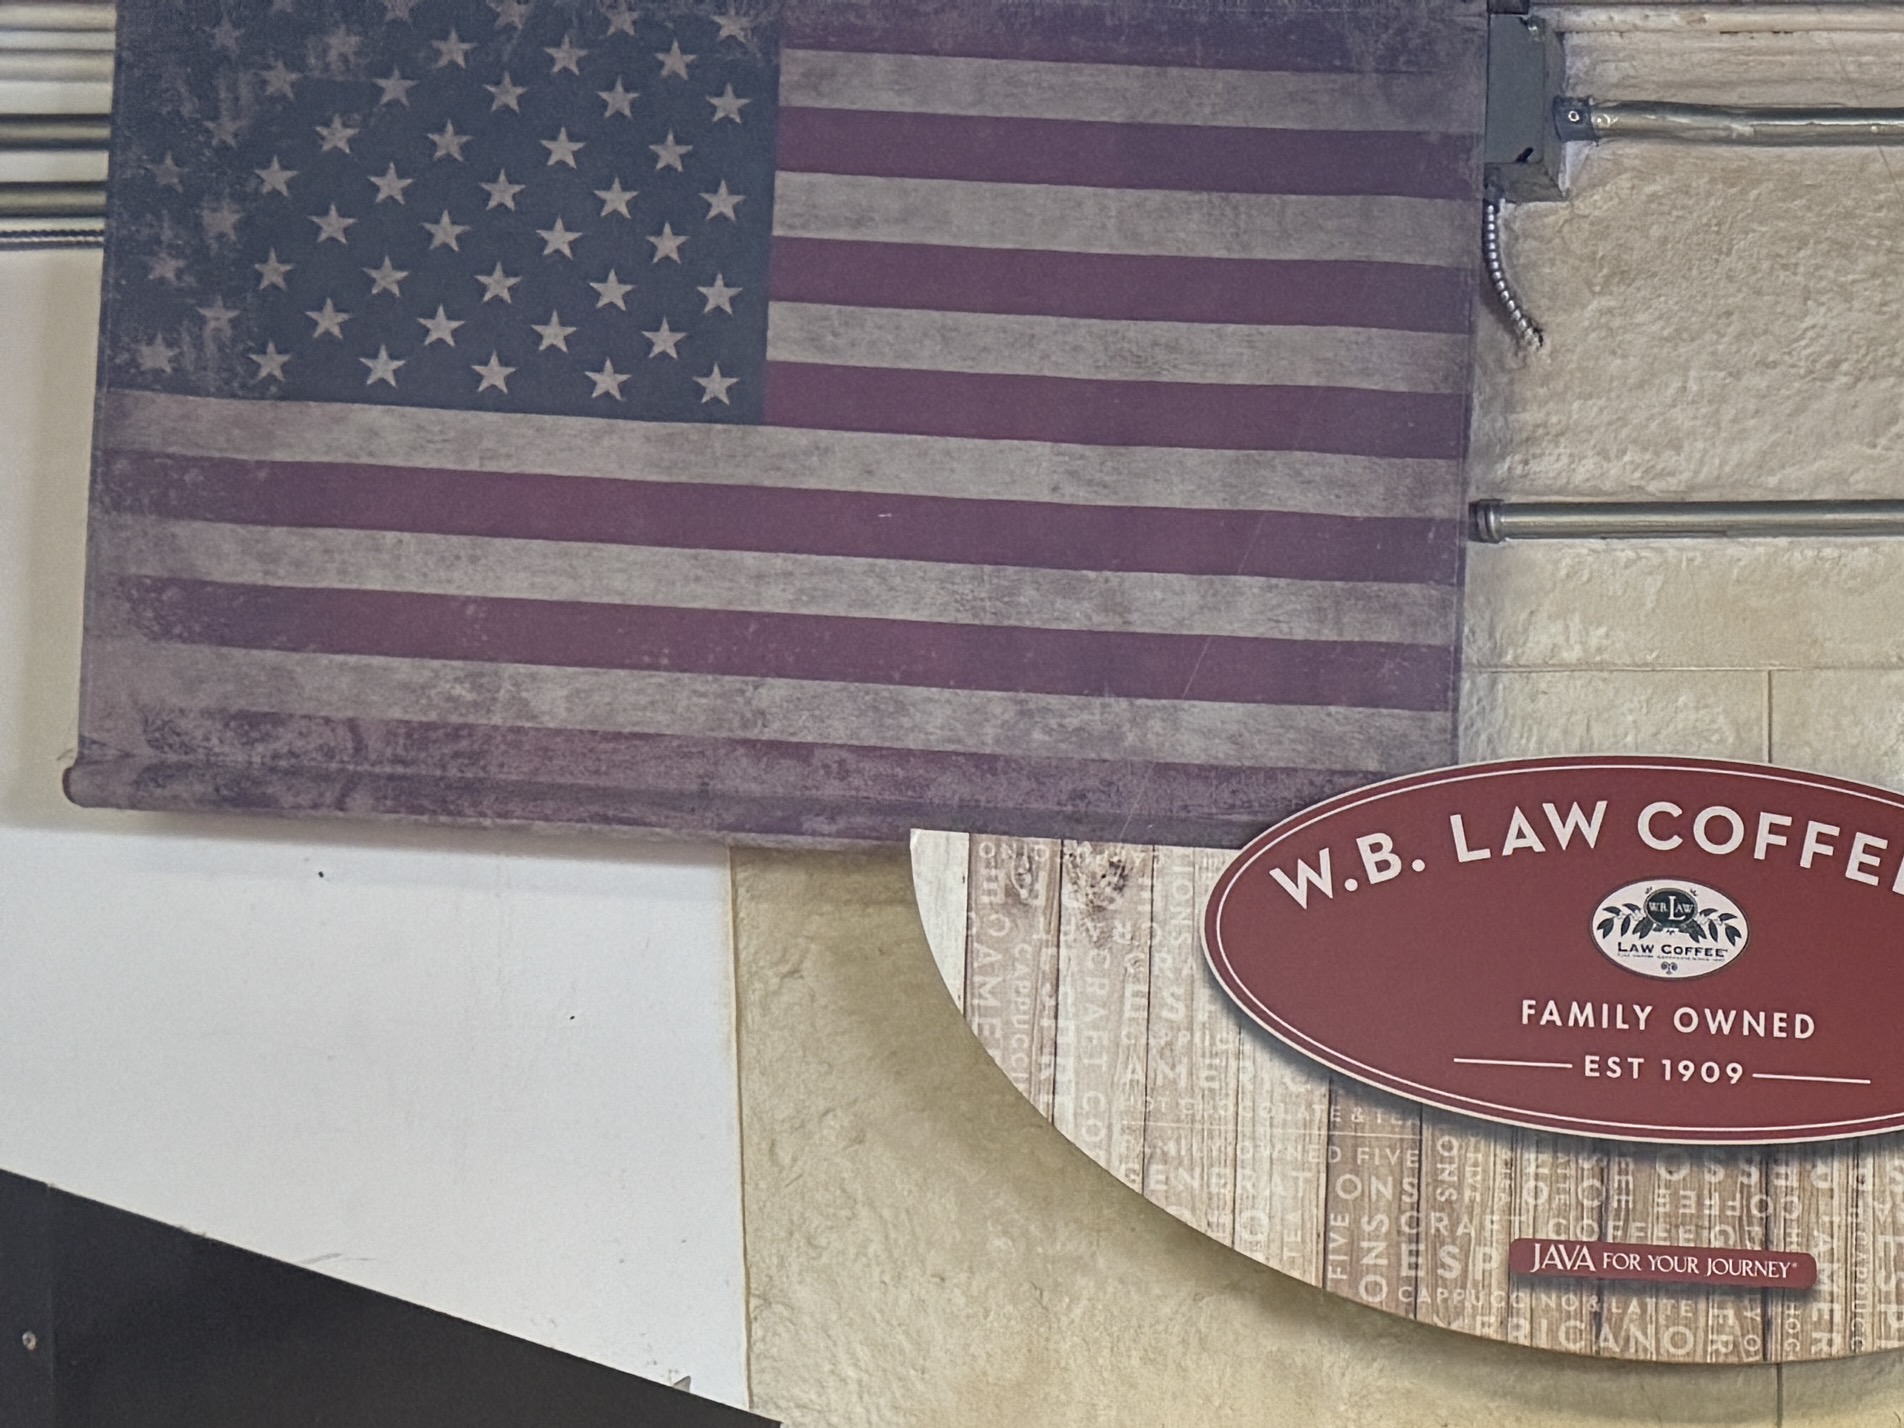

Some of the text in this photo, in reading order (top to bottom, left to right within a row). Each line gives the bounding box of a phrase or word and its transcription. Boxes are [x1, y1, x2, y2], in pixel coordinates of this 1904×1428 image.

[1270, 833, 1426, 909] W.B.
[1449, 800, 1608, 864] LAW
[1618, 942, 1654, 953] LAW
[1661, 944, 1725, 957] COFFEE
[1522, 1000, 1816, 1040] FAMILY OWNED
[1583, 1056, 1744, 1085] EST 1909
[1357, 1148, 1421, 1167] FIVE
[1530, 1243, 1596, 1272] JAVA
[1603, 1252, 1641, 1273] FOR
[1647, 1253, 1700, 1275] YOUR
